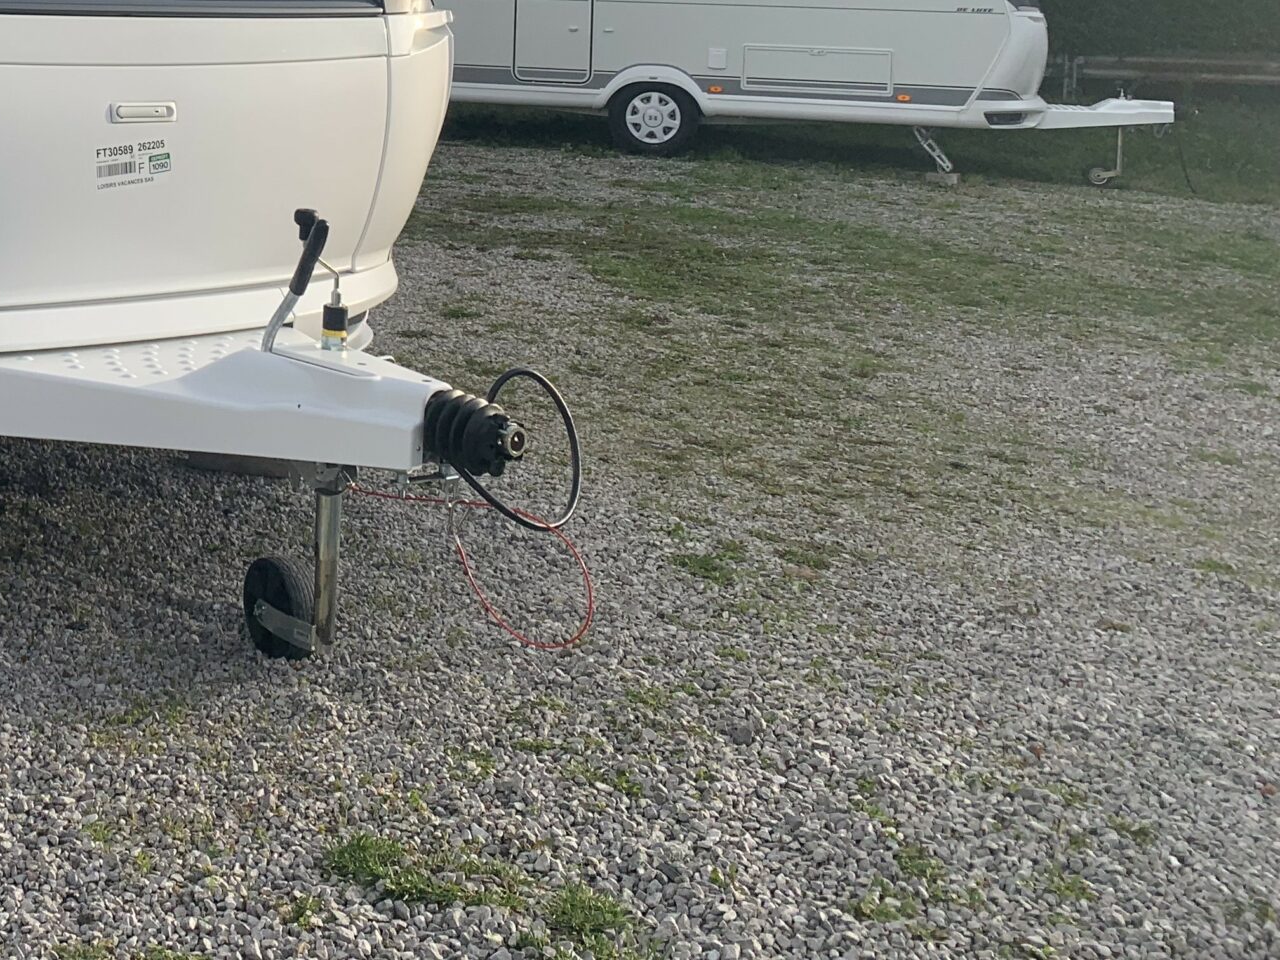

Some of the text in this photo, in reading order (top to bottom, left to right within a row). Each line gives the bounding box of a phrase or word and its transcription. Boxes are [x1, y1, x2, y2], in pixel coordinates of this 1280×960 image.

[96, 144, 133, 158] FT30589
[137, 139, 165, 151] 262205
[138, 162, 145, 174] F
[152, 161, 168, 170] 1090
[117, 178, 143, 186] VACANCES
